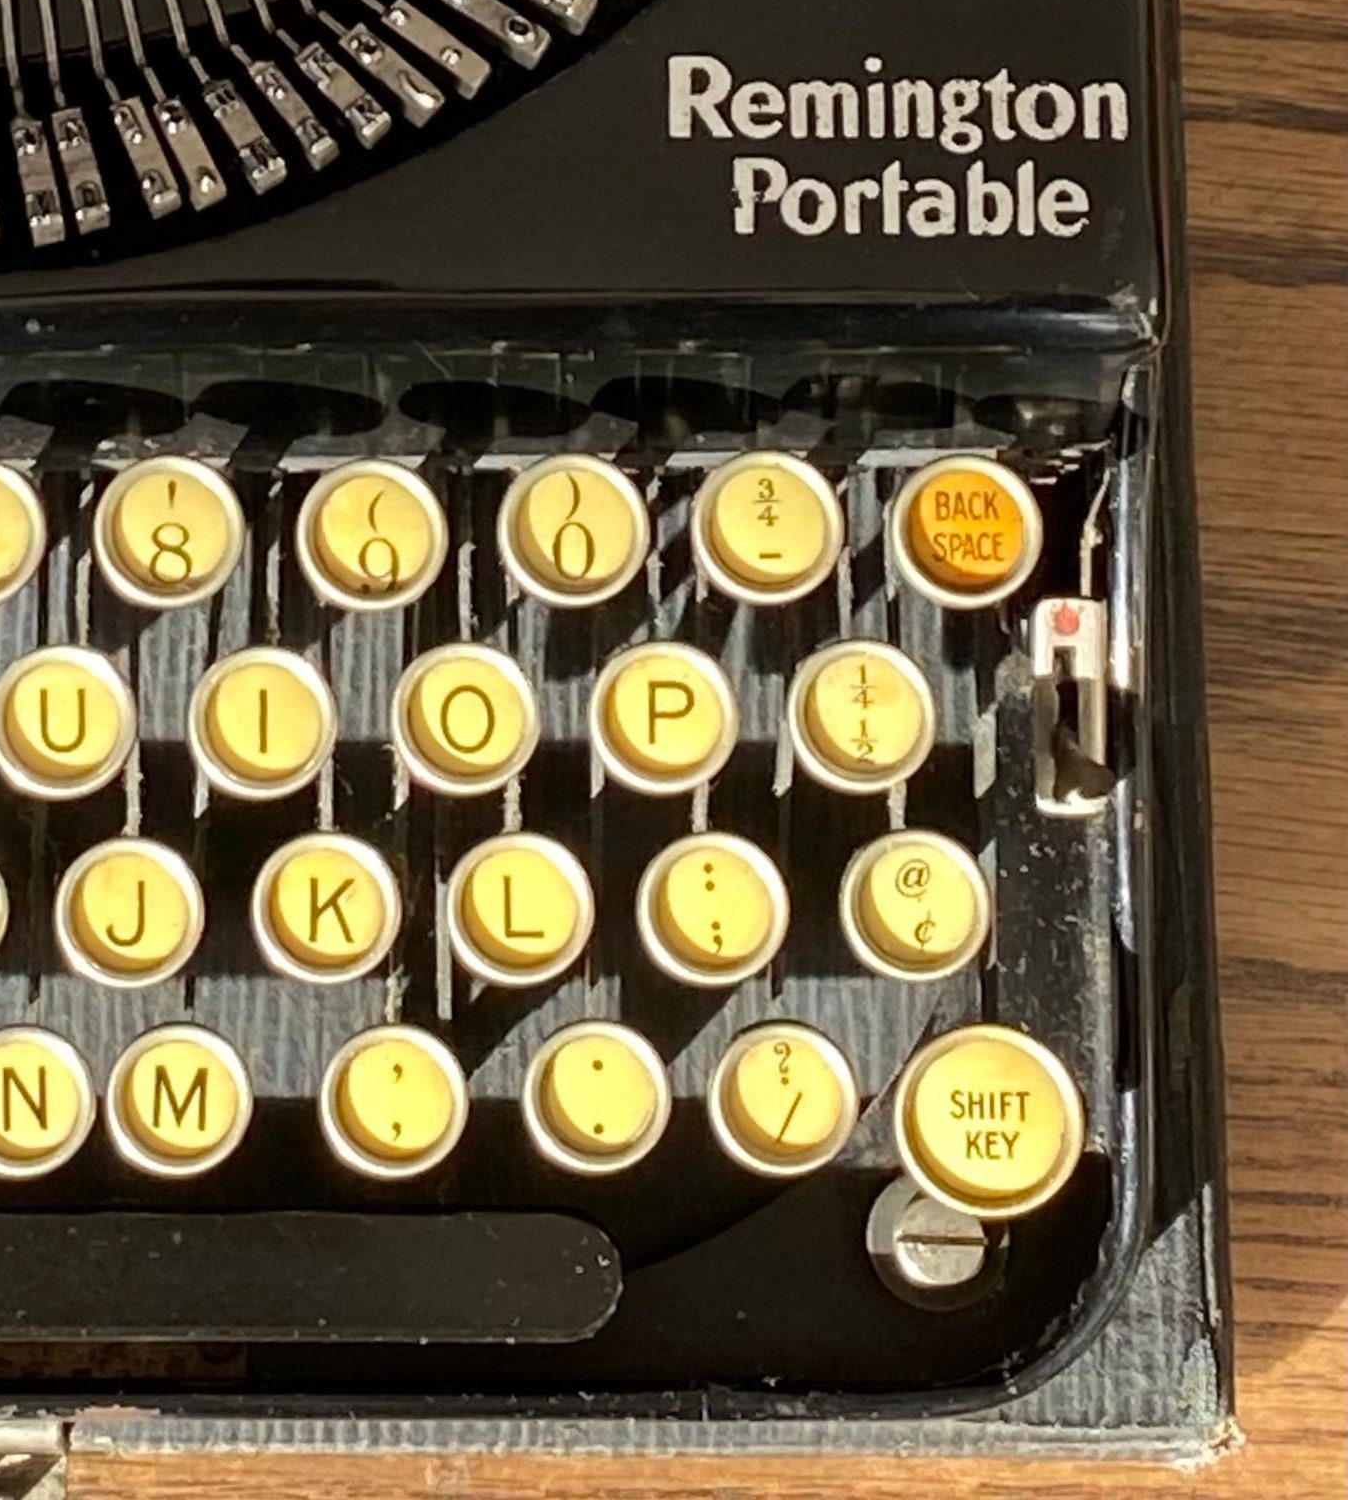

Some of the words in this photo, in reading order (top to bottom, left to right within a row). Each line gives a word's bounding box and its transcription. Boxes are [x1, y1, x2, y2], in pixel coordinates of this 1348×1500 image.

[667, 55, 1129, 154] Remington
[732, 156, 1090, 237] Portable
[935, 490, 1001, 522] BACK
[149, 522, 193, 584] 8
[358, 537, 400, 593] 9
[552, 522, 596, 580] 0
[931, 531, 1004, 563] SPACE
[39, 687, 87, 754] U
[257, 687, 269, 755] I
[440, 685, 495, 754] O
[647, 680, 695, 745] P
[503, 875, 545, 939] L
[894, 857, 931, 898] @
[105, 880, 146, 947] J
[307, 876, 355, 944] K
[773, 1041, 792, 1087] ?
[2, 1066, 48, 1132] N
[152, 1066, 209, 1132] M
[949, 1090, 1032, 1123] SHIFT
[964, 1130, 1018, 1160] KEY
